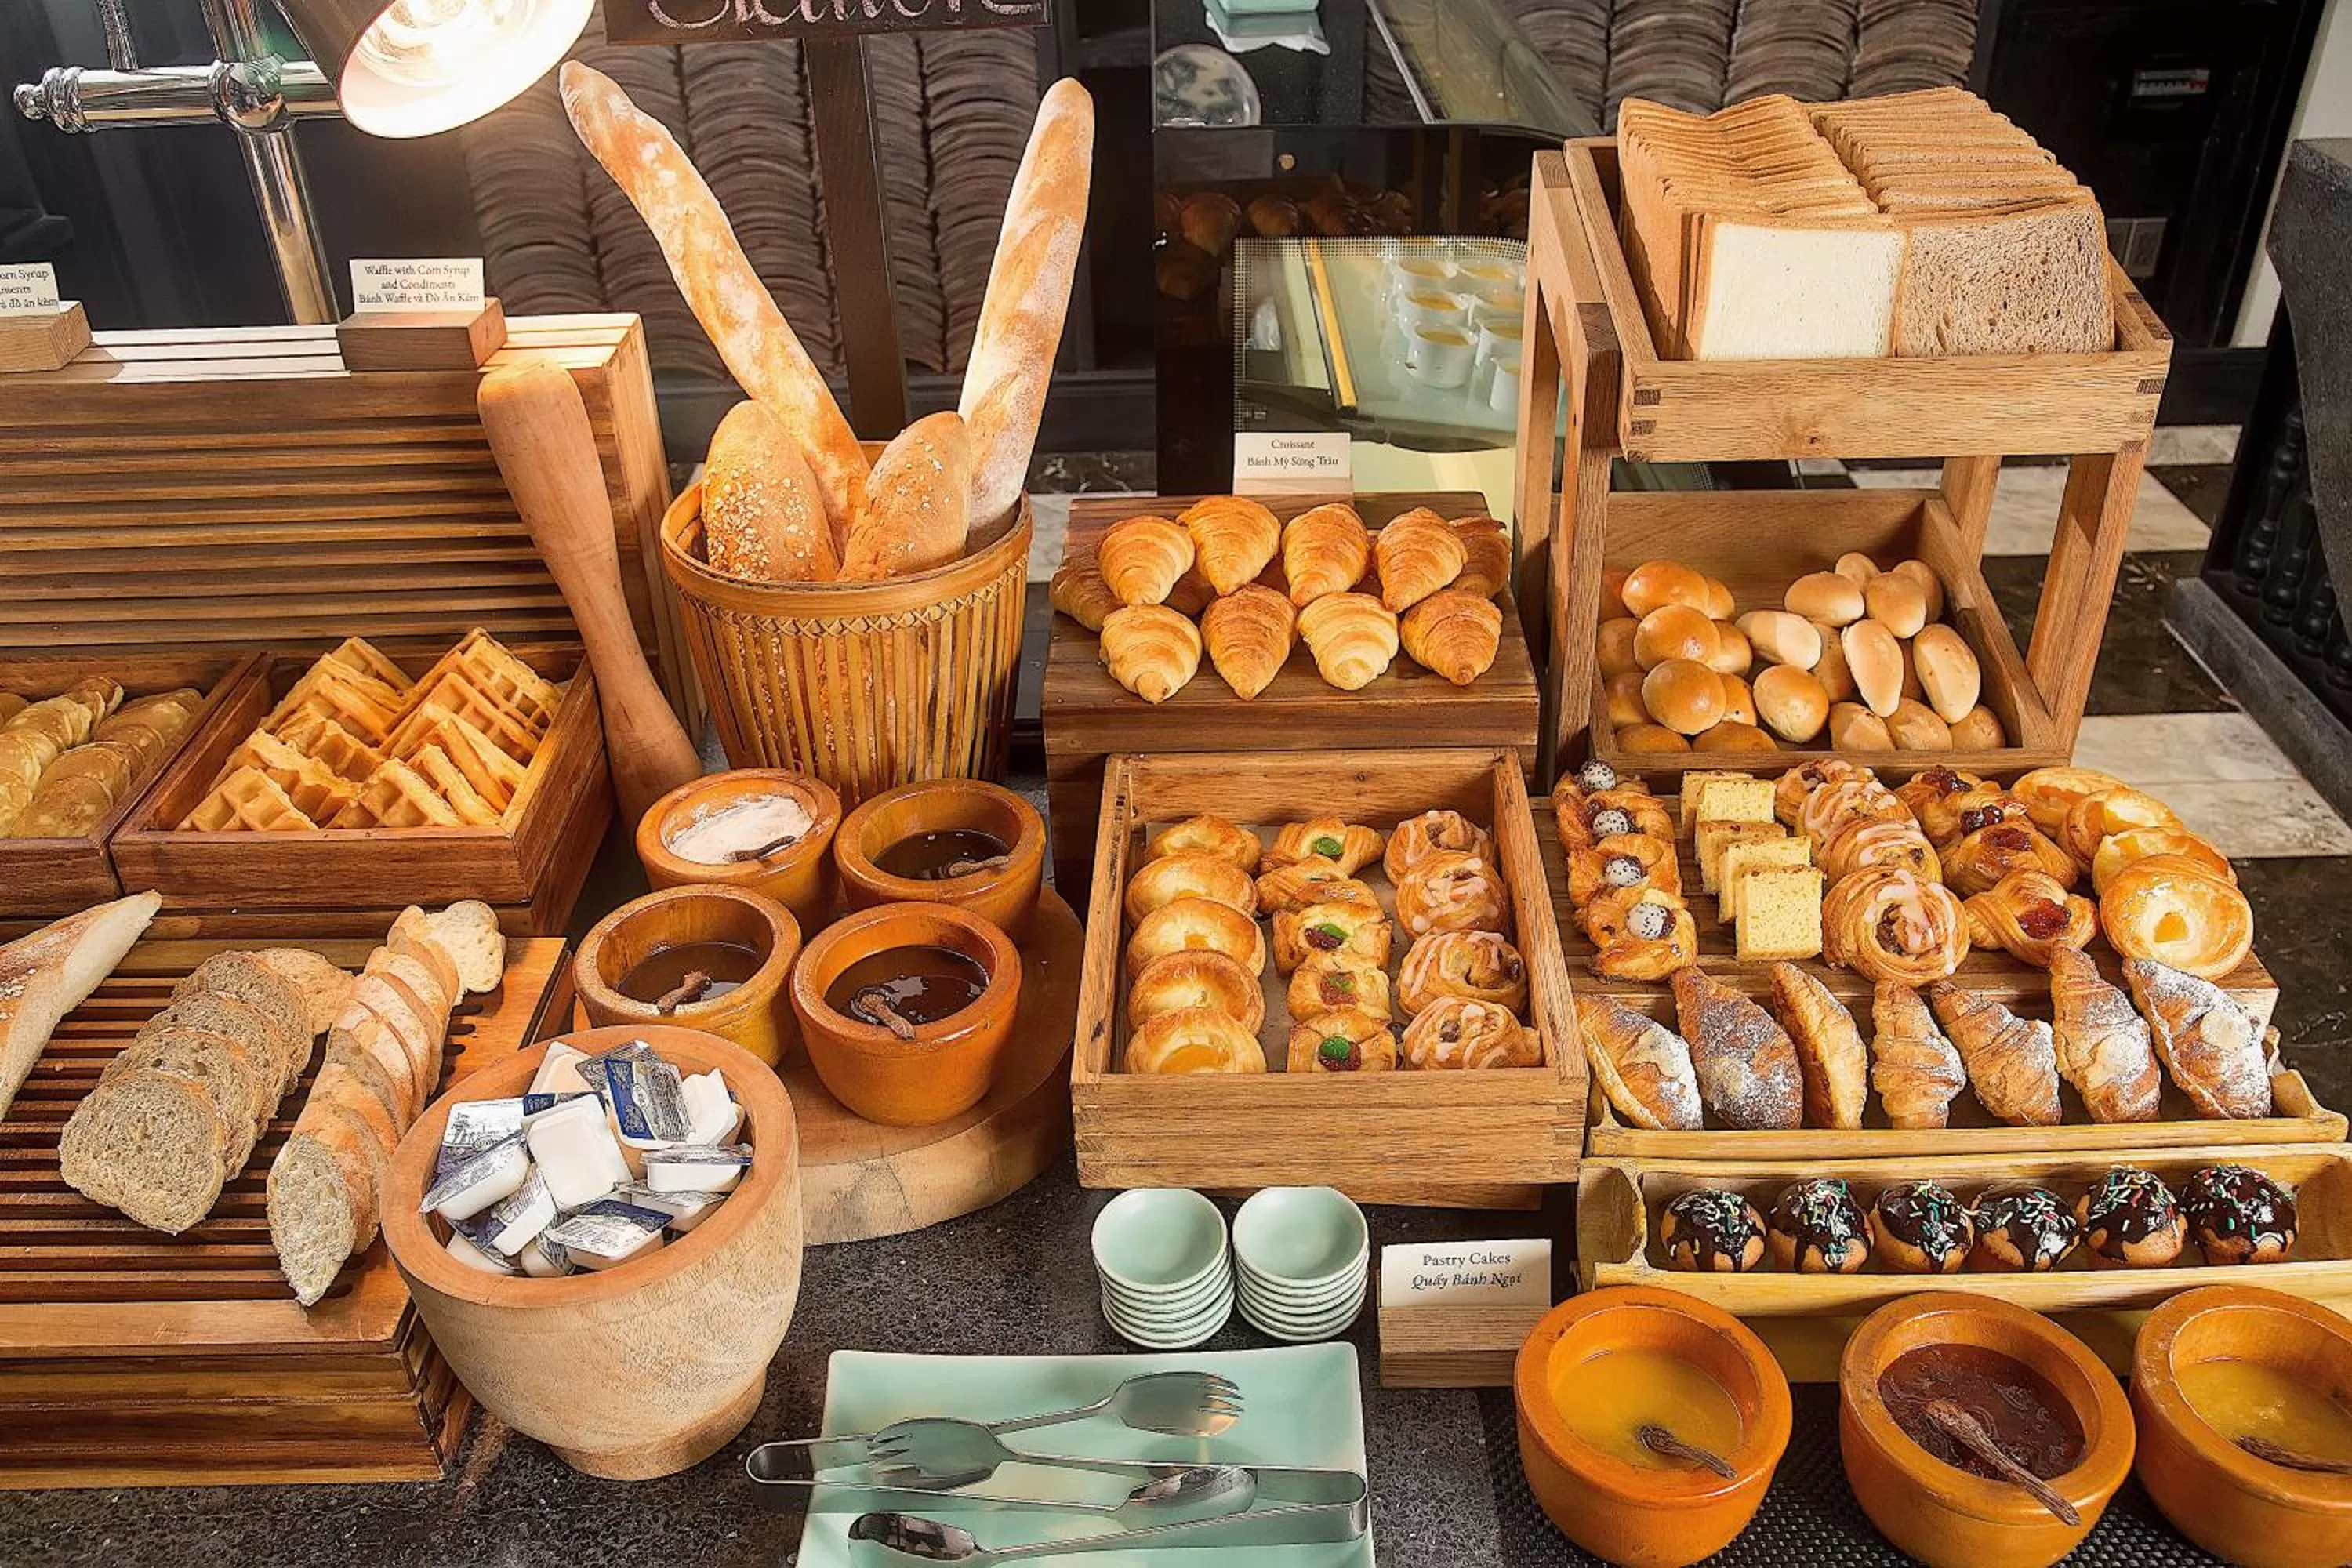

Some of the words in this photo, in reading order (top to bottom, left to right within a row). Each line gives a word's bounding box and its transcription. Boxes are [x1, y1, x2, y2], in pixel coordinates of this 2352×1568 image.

[18, 269, 49, 282] Syrup
[364, 264, 393, 275] Waffle
[394, 265, 416, 275] with
[417, 264, 441, 275] Corn
[443, 264, 470, 278] Syrup
[380, 278, 397, 289] and
[399, 278, 456, 289] Condiments
[358, 293, 383, 303] Bánh
[384, 292, 412, 303] Waffle
[1270, 438, 1316, 449] Croissant
[1247, 456, 1272, 466] Bánh
[1422, 1254, 1466, 1268] Pastry
[1469, 1251, 1512, 1265] Cakes
[1452, 1272, 1486, 1287] Bánh
[1490, 1271, 1523, 1288] Ngọt
